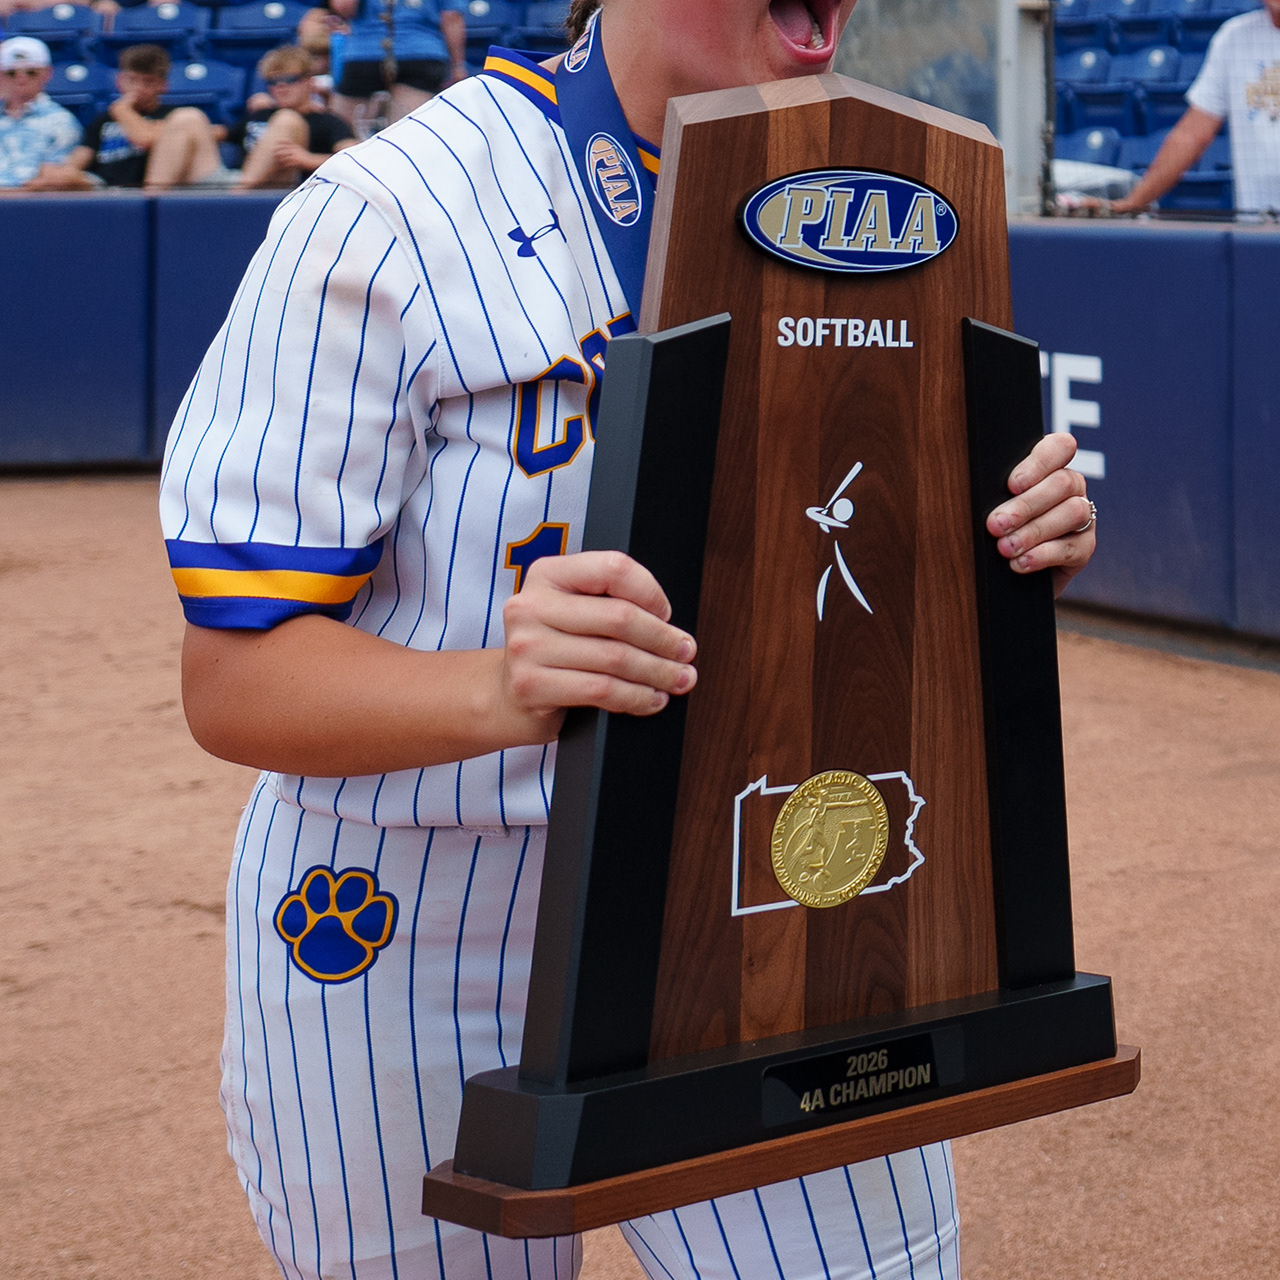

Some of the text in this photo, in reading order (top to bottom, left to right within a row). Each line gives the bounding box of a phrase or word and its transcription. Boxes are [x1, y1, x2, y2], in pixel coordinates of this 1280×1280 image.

[592, 143, 640, 221] PIAA
[777, 184, 942, 254] PIAA
[777, 316, 914, 348] SOFTBALL
[800, 1063, 932, 1113] 4A CHAMPION
[847, 1049, 889, 1077] 2026
